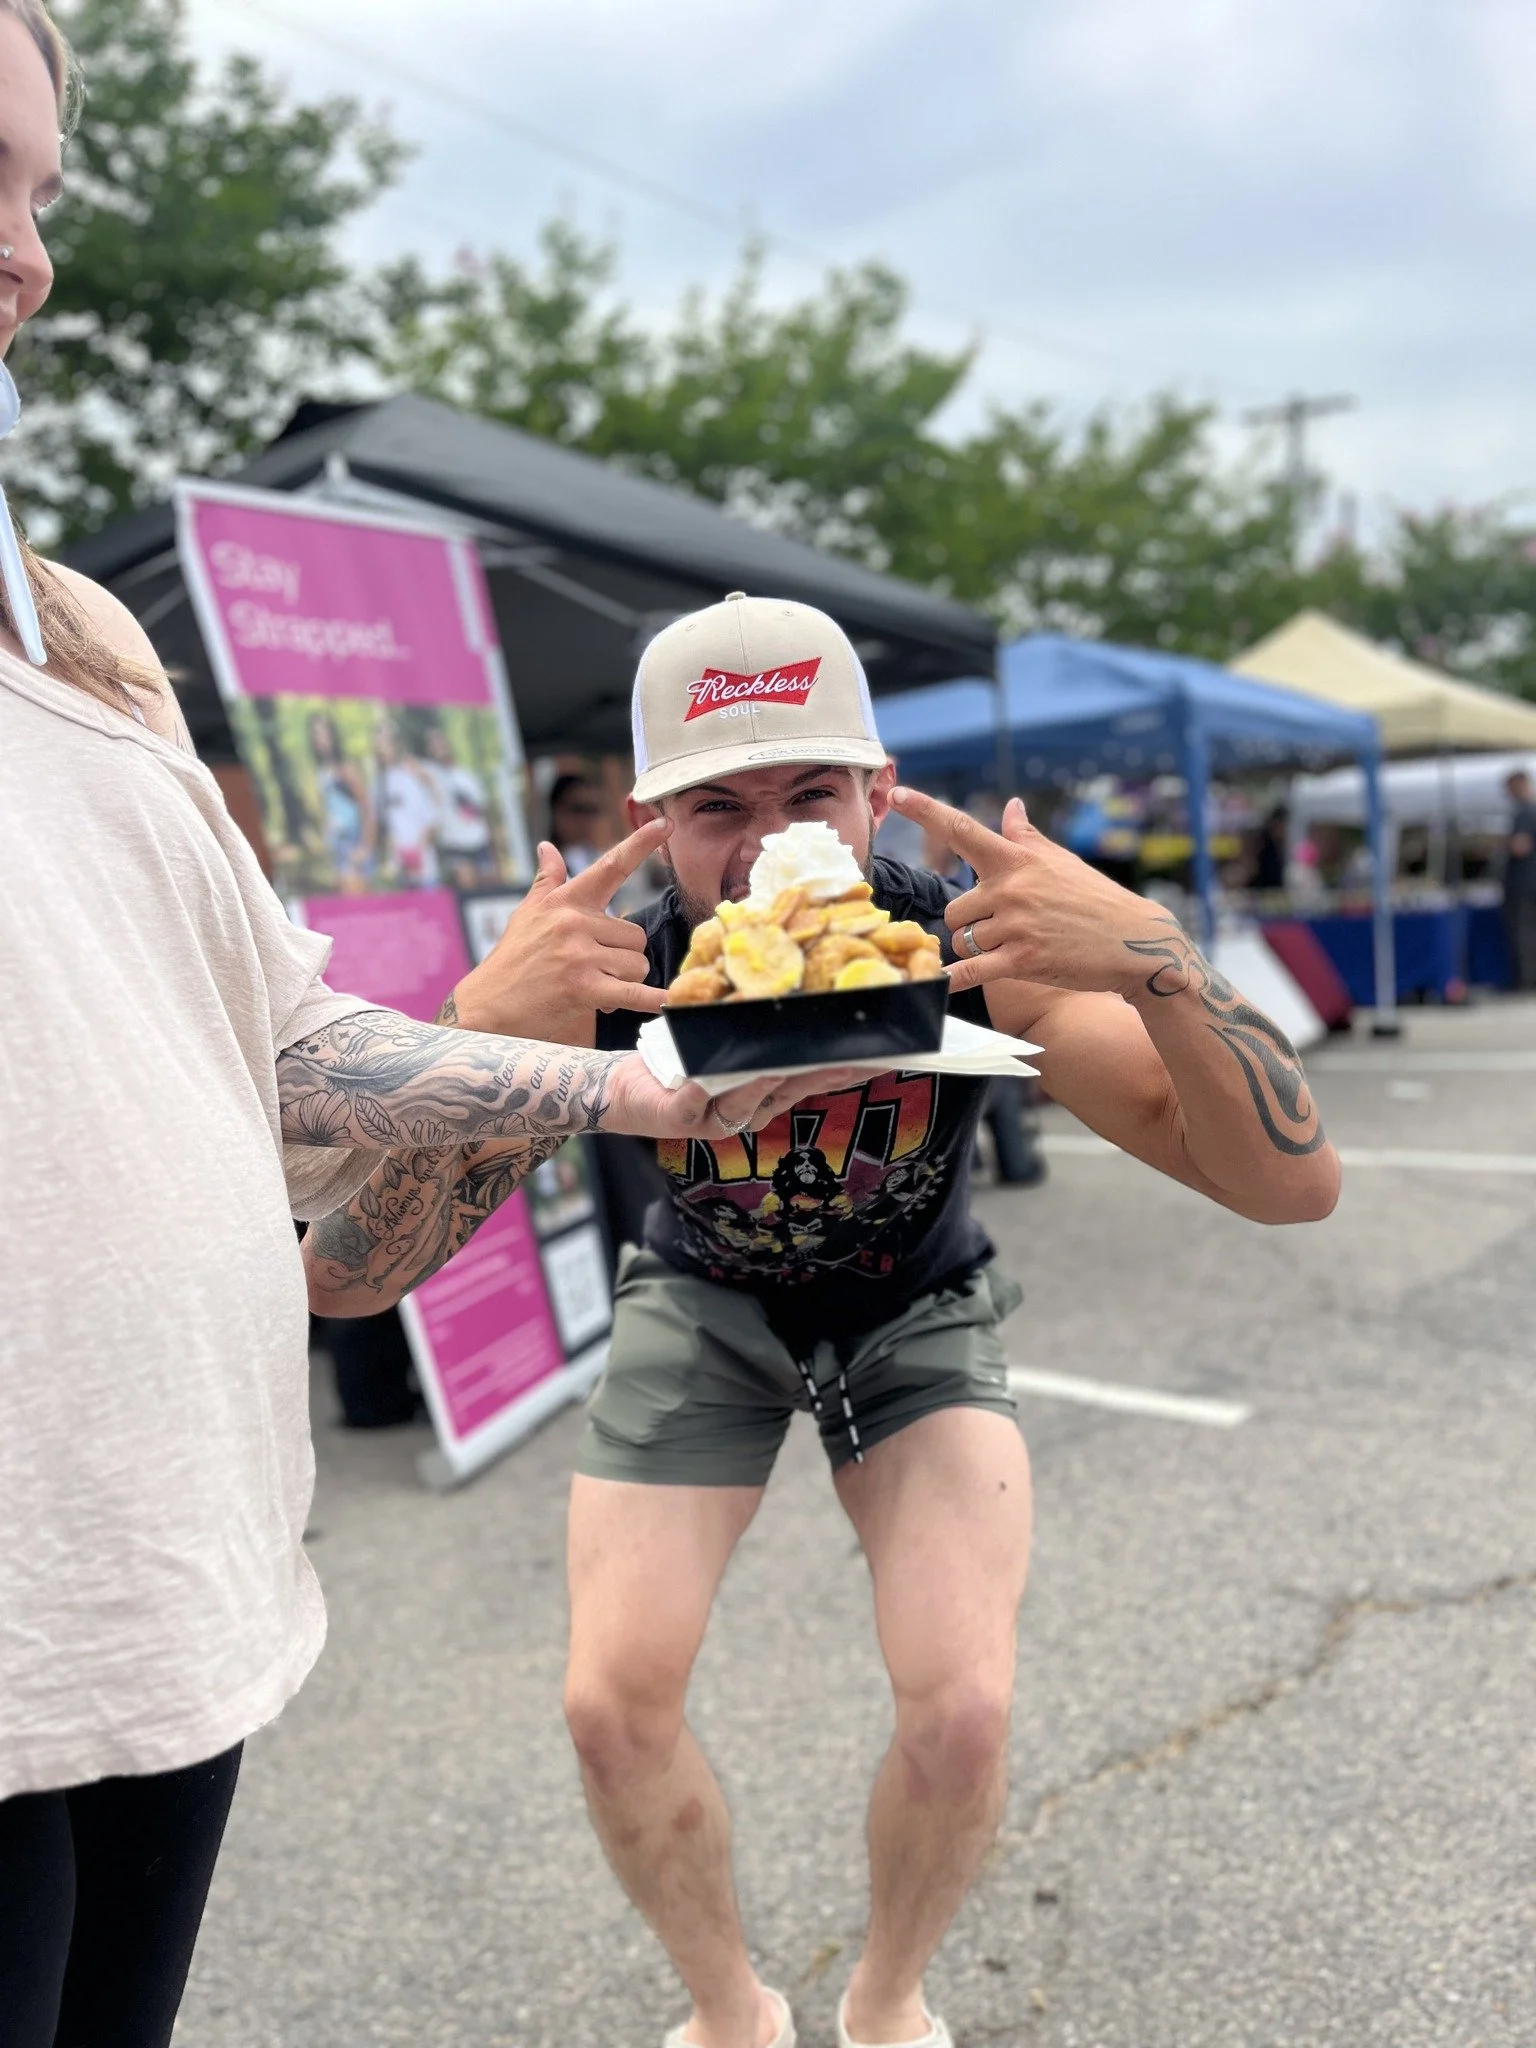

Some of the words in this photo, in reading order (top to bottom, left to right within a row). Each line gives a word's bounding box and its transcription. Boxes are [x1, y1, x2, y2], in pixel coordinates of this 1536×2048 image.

[211, 541, 301, 604] Stay
[687, 671, 818, 704] Reckless
[719, 704, 761, 719] SOUL
[531, 1054, 552, 1090] and
[557, 1063, 579, 1103] with
